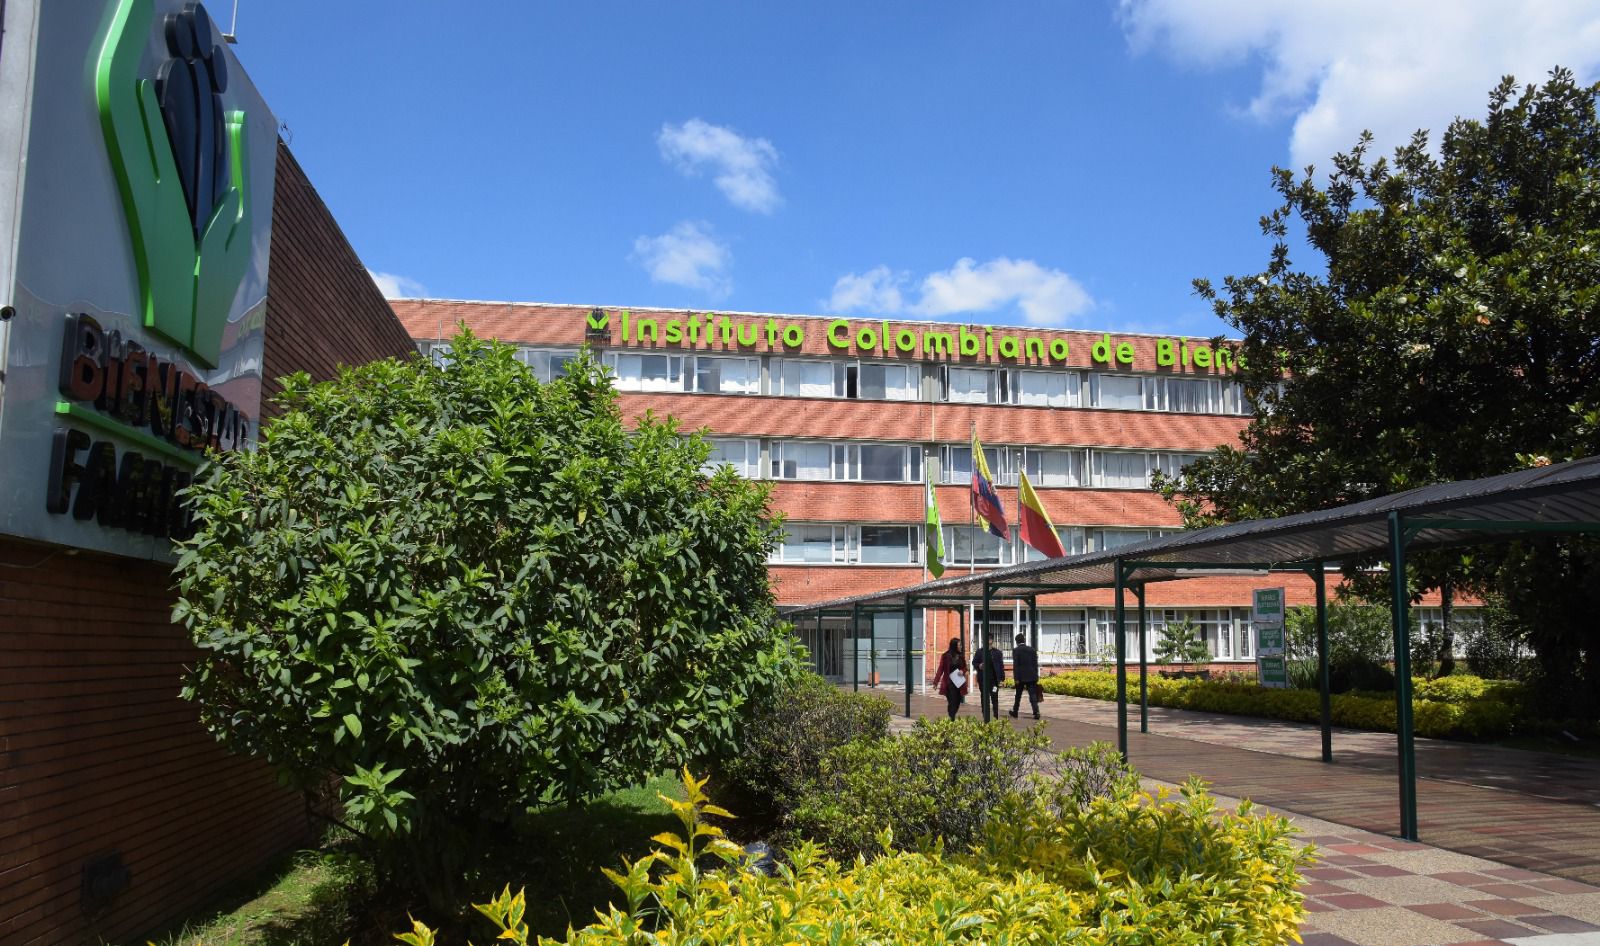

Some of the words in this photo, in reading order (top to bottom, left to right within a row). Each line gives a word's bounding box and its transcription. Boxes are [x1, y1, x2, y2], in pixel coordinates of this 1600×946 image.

[621, 310, 805, 349] Instituto
[827, 318, 1070, 362] Colombiano
[1091, 333, 1136, 364] de
